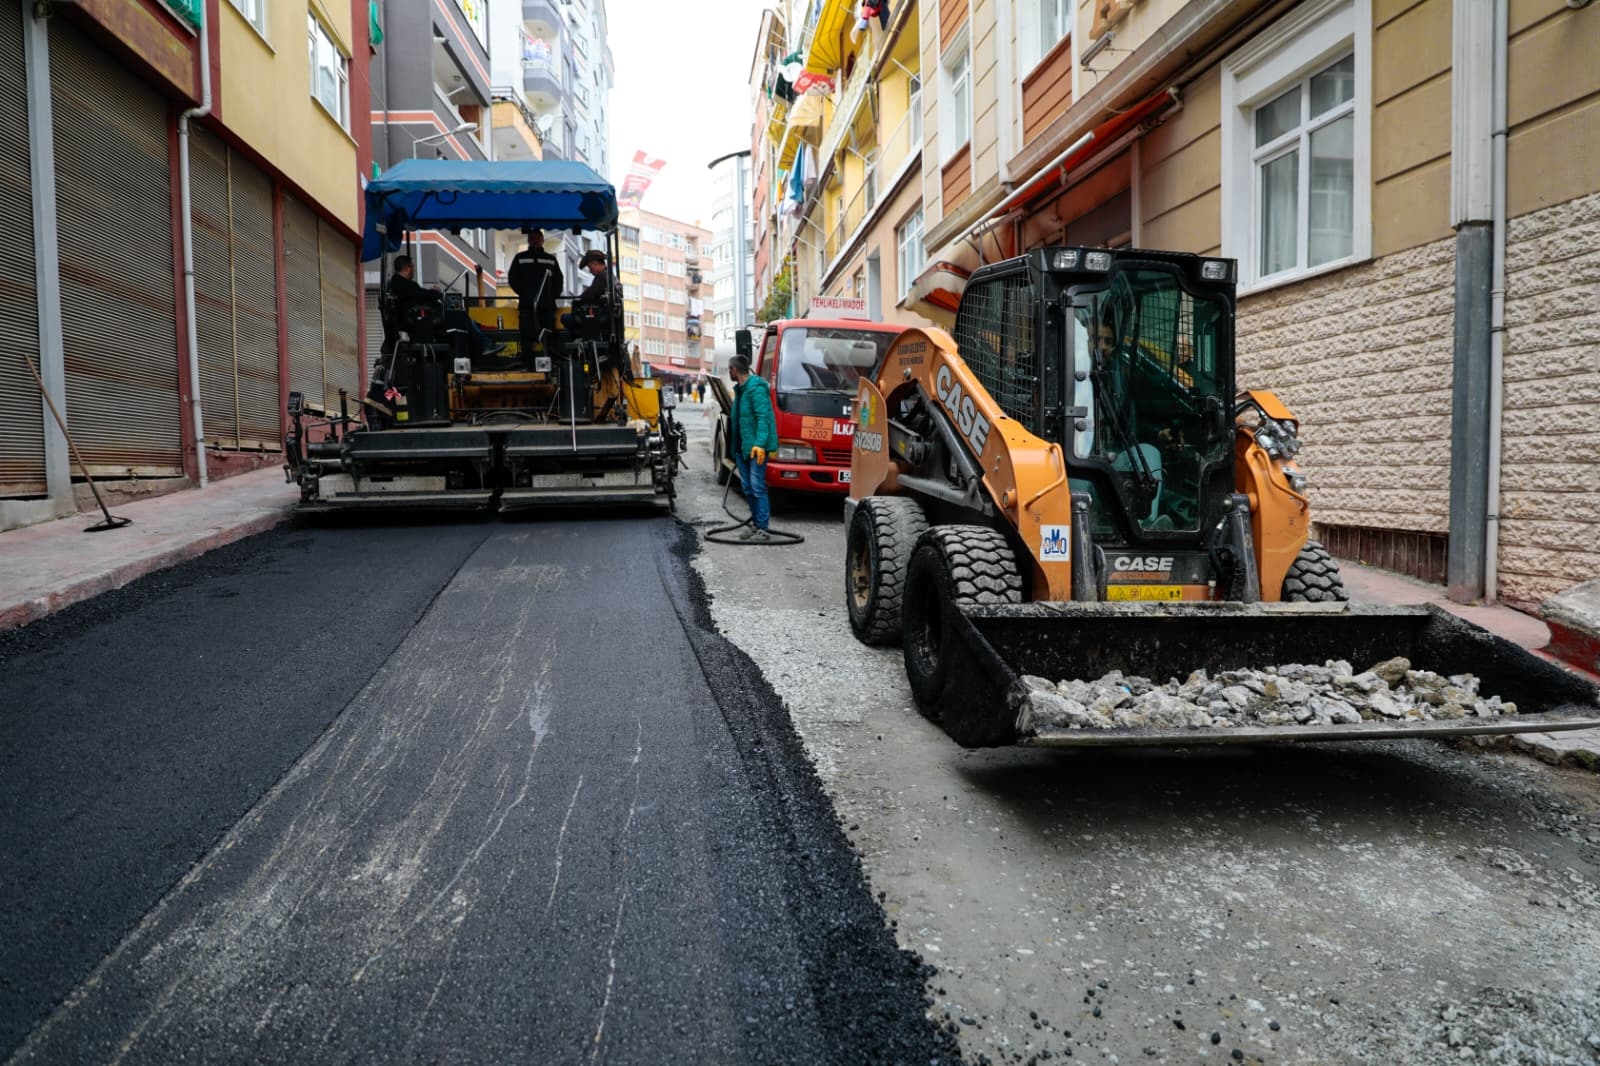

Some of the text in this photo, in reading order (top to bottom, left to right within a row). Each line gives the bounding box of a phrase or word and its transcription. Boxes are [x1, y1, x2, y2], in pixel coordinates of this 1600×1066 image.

[842, 299, 865, 310] MADDE
[936, 364, 990, 457] CASE
[814, 418, 824, 427] 30
[808, 430, 829, 440] 1202
[1114, 556, 1174, 571] CASE
